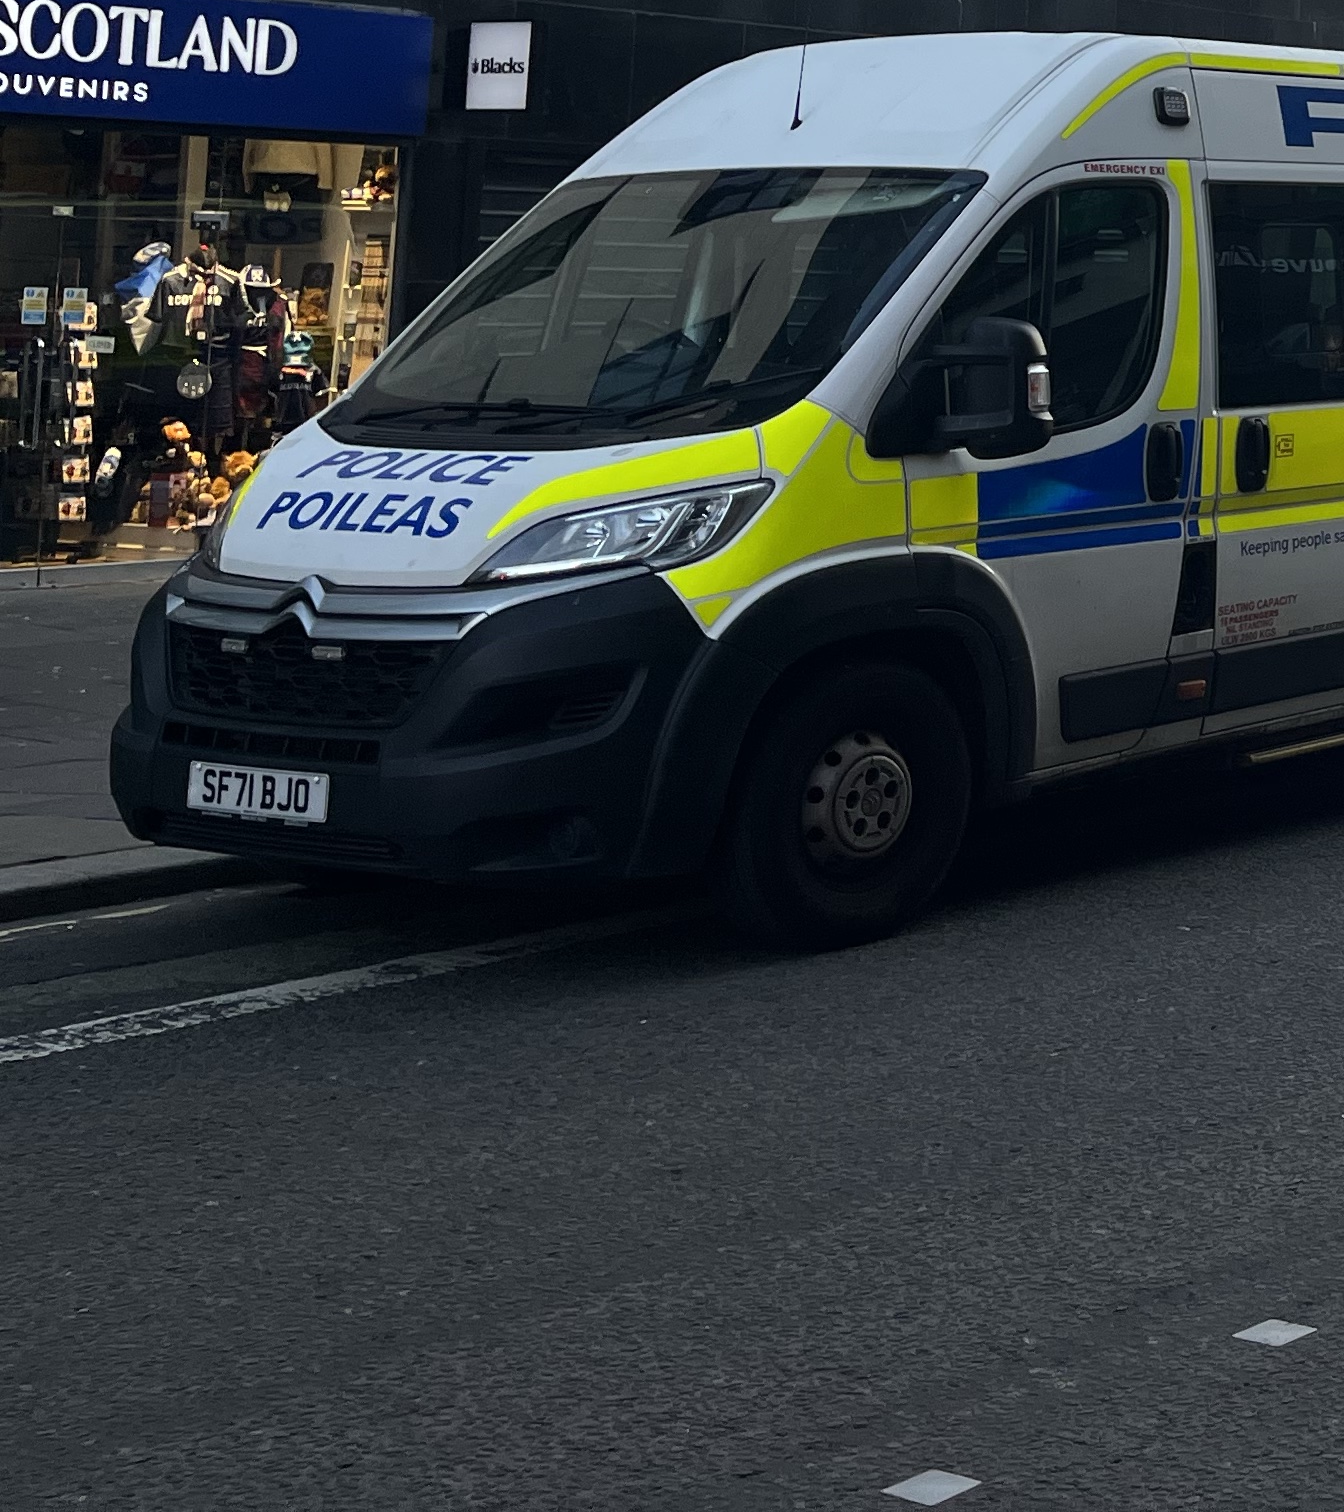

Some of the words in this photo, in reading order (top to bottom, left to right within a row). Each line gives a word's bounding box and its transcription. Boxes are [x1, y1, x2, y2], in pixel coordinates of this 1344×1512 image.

[480, 57, 525, 75] Blacks
[1084, 163, 1147, 175] EMERGENCY
[295, 450, 535, 486] POLICE
[256, 490, 474, 539] POILEAS
[1240, 540, 1289, 557] Keeping
[1292, 530, 1332, 553] people
[1217, 600, 1256, 617] SEATING
[1256, 593, 1299, 610] CAPACITY
[201, 769, 254, 808] SF71
[259, 776, 311, 814] BJO
